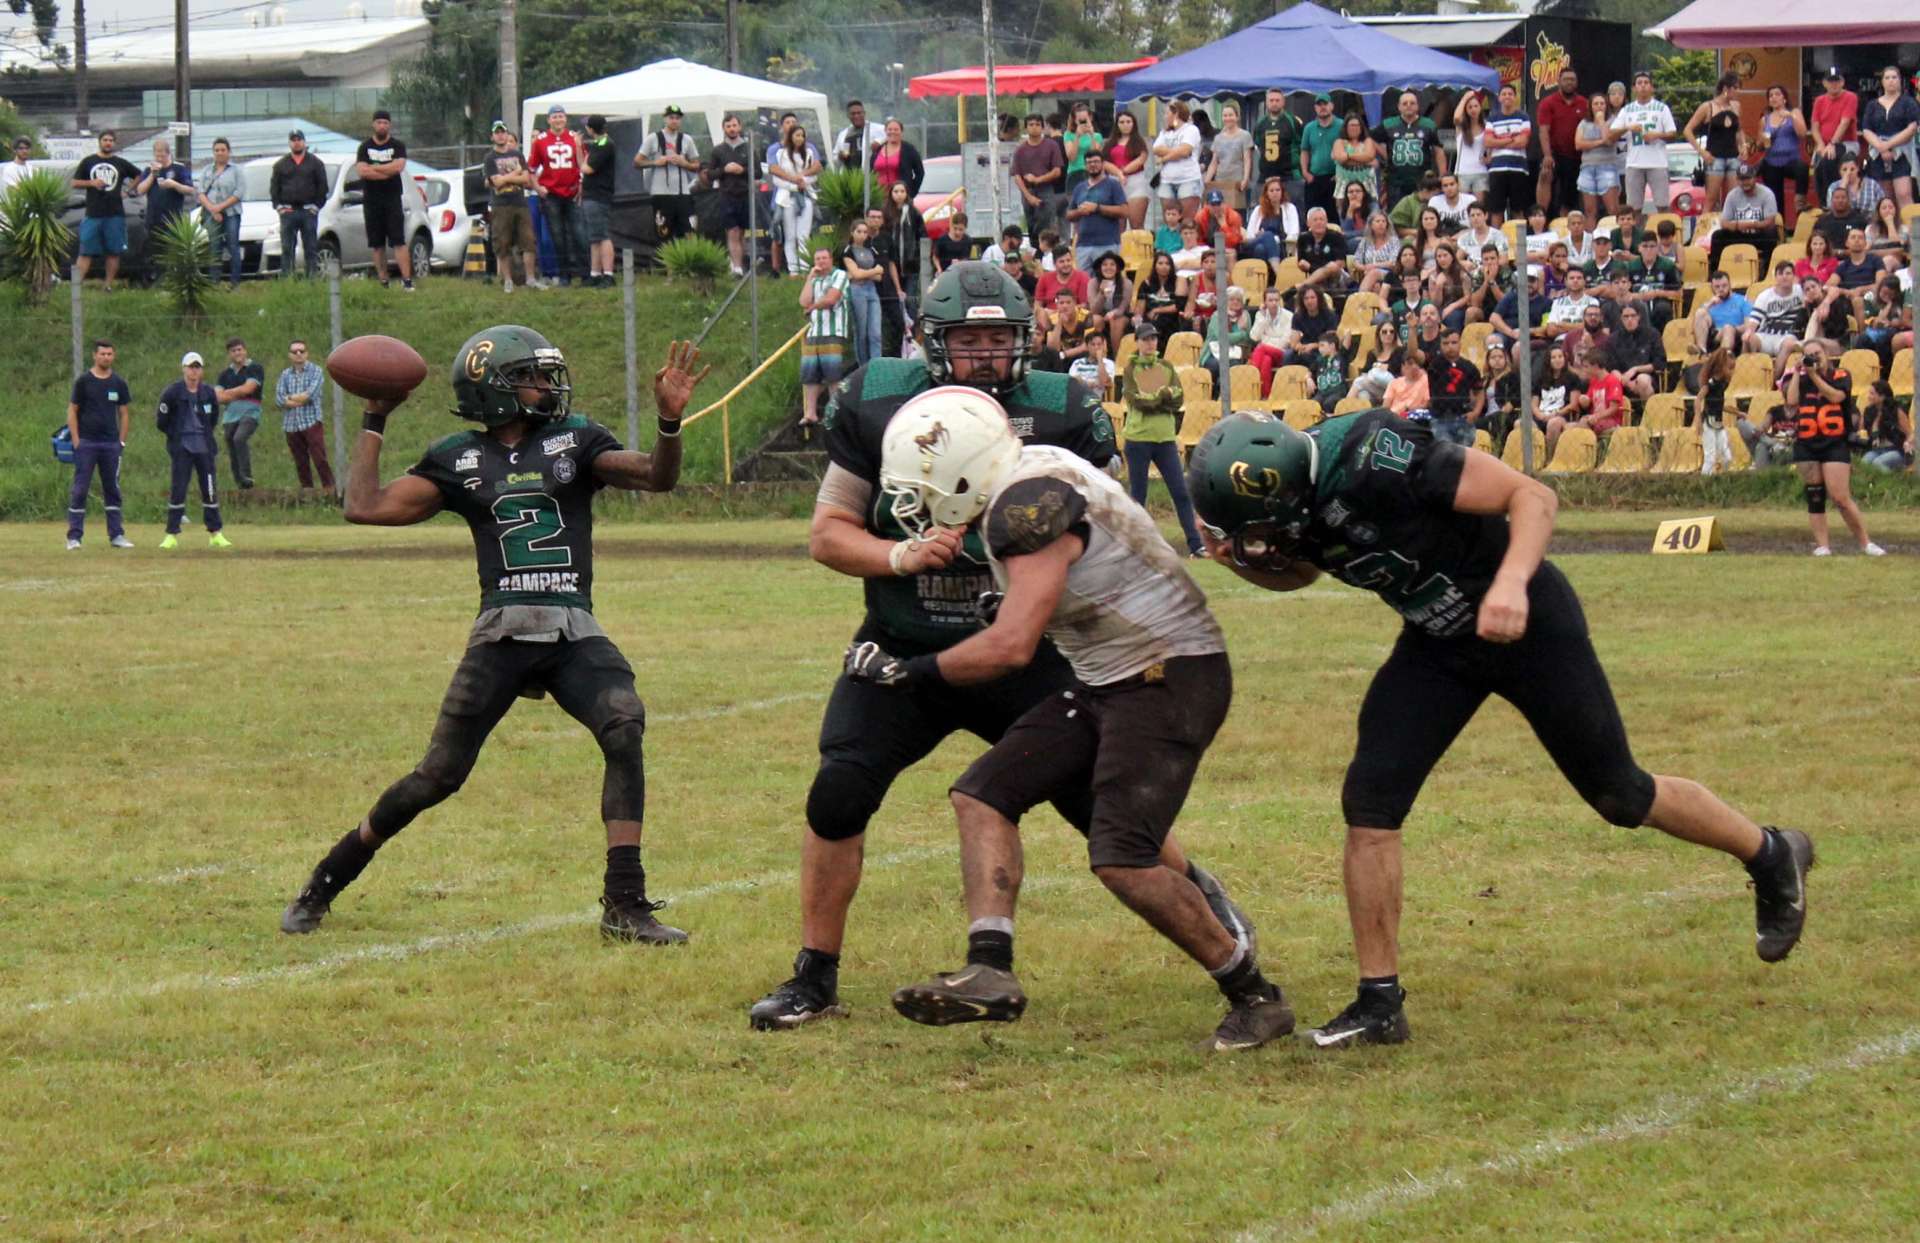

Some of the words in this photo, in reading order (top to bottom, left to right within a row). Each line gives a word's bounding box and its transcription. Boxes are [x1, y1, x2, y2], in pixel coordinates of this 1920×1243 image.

[547, 144, 573, 169] 52
[1264, 133, 1280, 162] 5
[1392, 138, 1424, 167] 85
[1797, 404, 1845, 439] 56
[1371, 427, 1415, 474] 12
[490, 492, 572, 570] 2
[1662, 524, 1702, 550] 40
[498, 572, 580, 593] RAMPAGE
